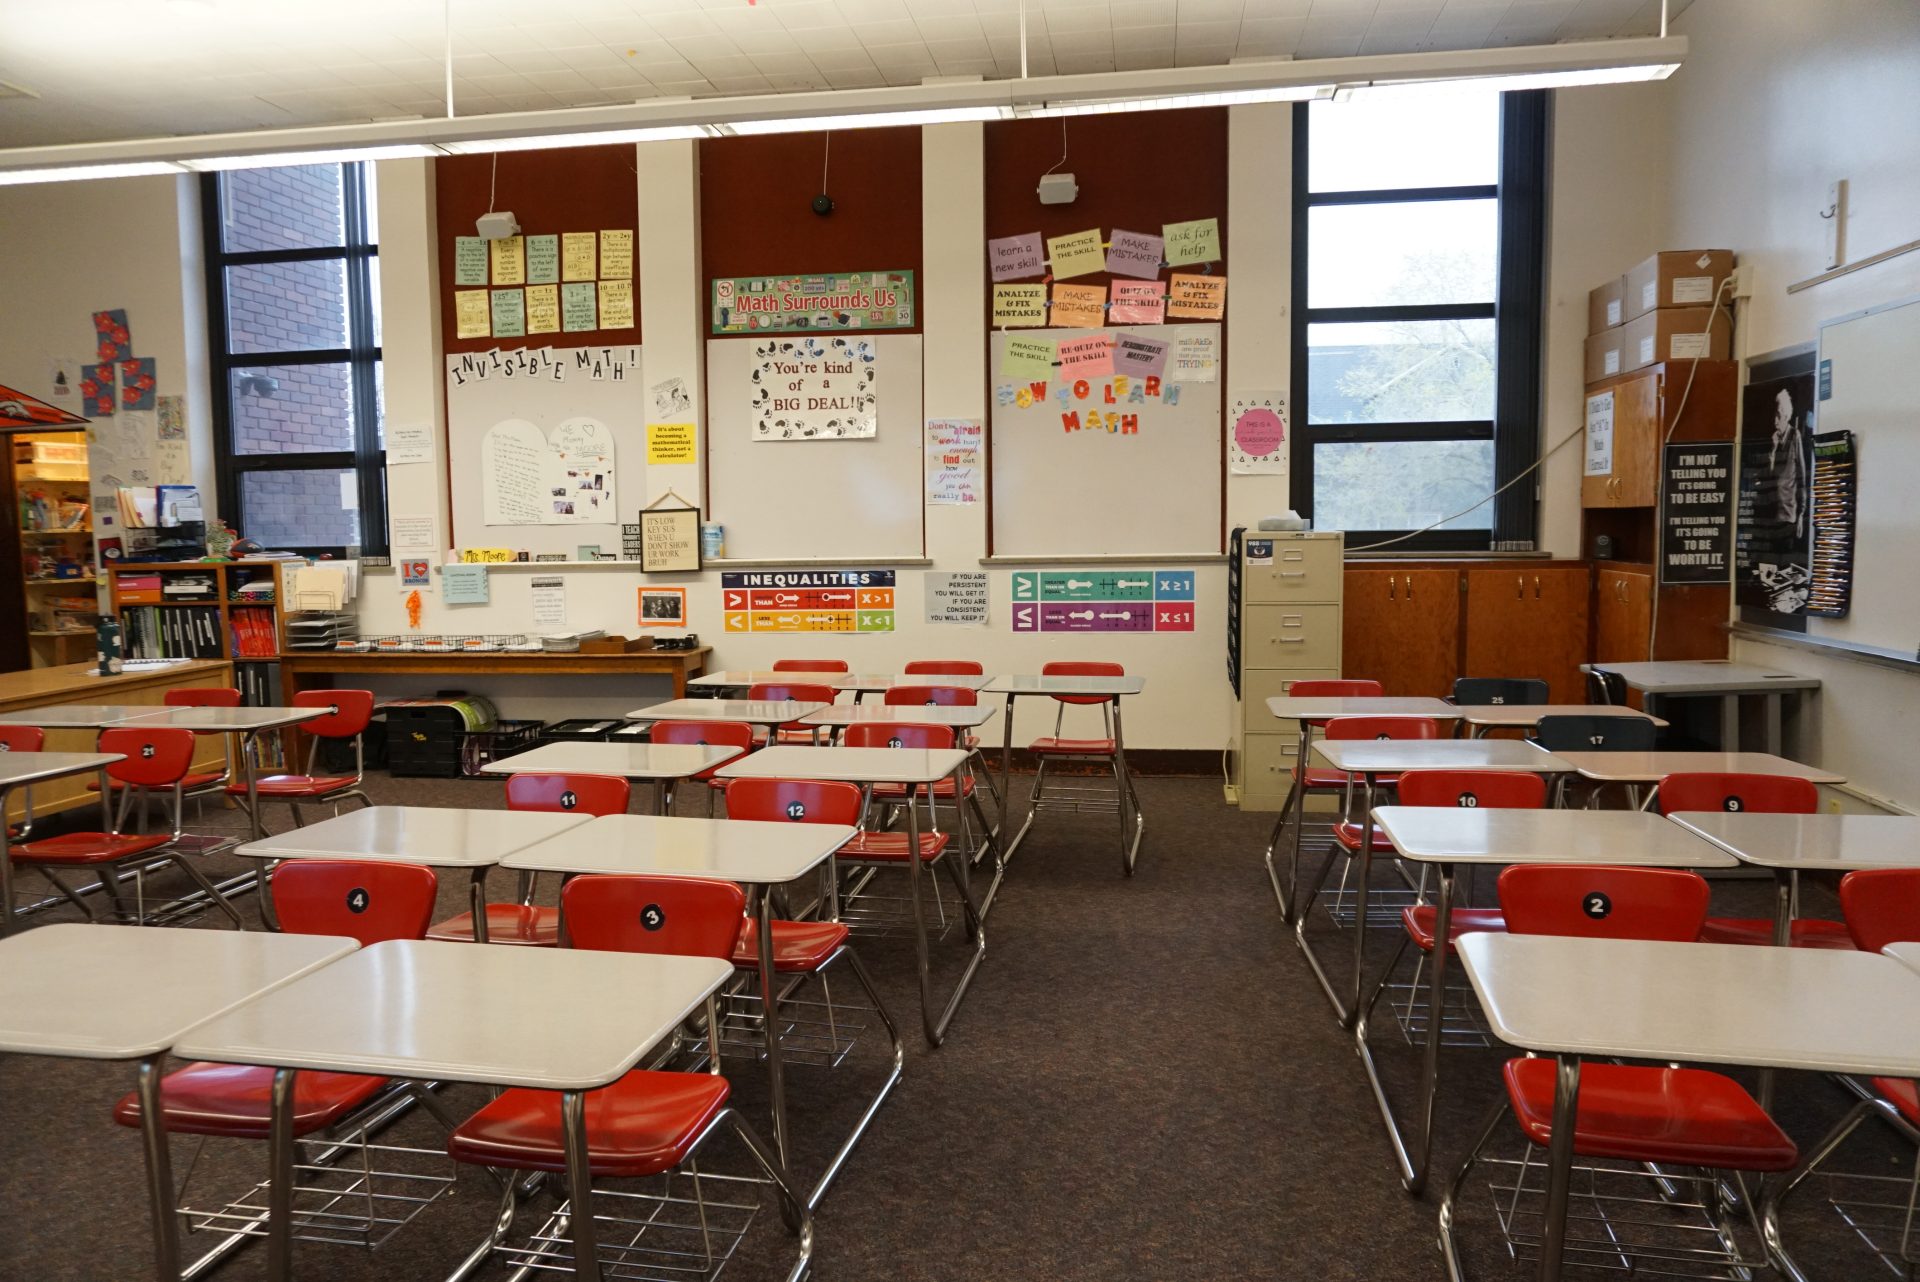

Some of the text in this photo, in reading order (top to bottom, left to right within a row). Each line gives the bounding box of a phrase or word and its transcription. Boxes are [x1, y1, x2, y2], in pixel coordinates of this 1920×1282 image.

[1170, 228, 1213, 243] ask for
[1055, 237, 1095, 250] PRACTICE
[1121, 239, 1150, 251] MAKE
[998, 247, 1023, 256] learn
[1074, 248, 1096, 256] SKILL
[1180, 243, 1205, 257] help
[1110, 249, 1158, 264] MISTAKES
[995, 257, 1037, 272] new skill
[1175, 281, 1219, 289] ANALYZE
[736, 289, 895, 313] Math Surrounds Us
[1063, 291, 1093, 300] MAKE
[1053, 305, 1102, 313] MISTAKES
[1171, 300, 1219, 309] MISTAKES
[1011, 342, 1050, 353] PRACTICE
[1061, 341, 1107, 355] RE-QUIZ ON
[1026, 353, 1048, 362] SKILL
[1063, 352, 1108, 365] THE SKILL
[452, 349, 563, 385] INVISIBLE
[774, 361, 853, 374] You're kind
[788, 379, 830, 391] of a
[773, 398, 801, 411] BIG
[1061, 407, 1138, 435] MATH
[954, 426, 981, 435] afraid
[943, 455, 959, 464] find
[1679, 454, 1718, 466] I'M NOT
[1671, 468, 1727, 479] TELLING YOU
[1678, 481, 1716, 490] IT'S GOING
[1670, 492, 1725, 504] TO BE EASY
[1669, 517, 1680, 525] I'M
[1682, 517, 1709, 525] TELLING
[647, 526, 661, 534] KEY
[1676, 528, 1719, 537] IT'S GOING
[648, 541, 689, 550] DON'T SHOW
[1684, 540, 1711, 550] TO BE
[1669, 553, 1709, 566] WORTH
[403, 564, 410, 577] I
[743, 573, 870, 587] INEQUALITIES
[1492, 696, 1504, 704] 25
[888, 740, 902, 749] 19
[1590, 736, 1604, 745] 17
[142, 747, 155, 756] 21
[562, 795, 576, 806] 11
[1458, 796, 1476, 807] 10
[1728, 800, 1738, 811] 9
[787, 805, 804, 817] 12
[352, 893, 364, 907] 4
[1590, 898, 1604, 913] 2
[647, 910, 659, 924] 3
